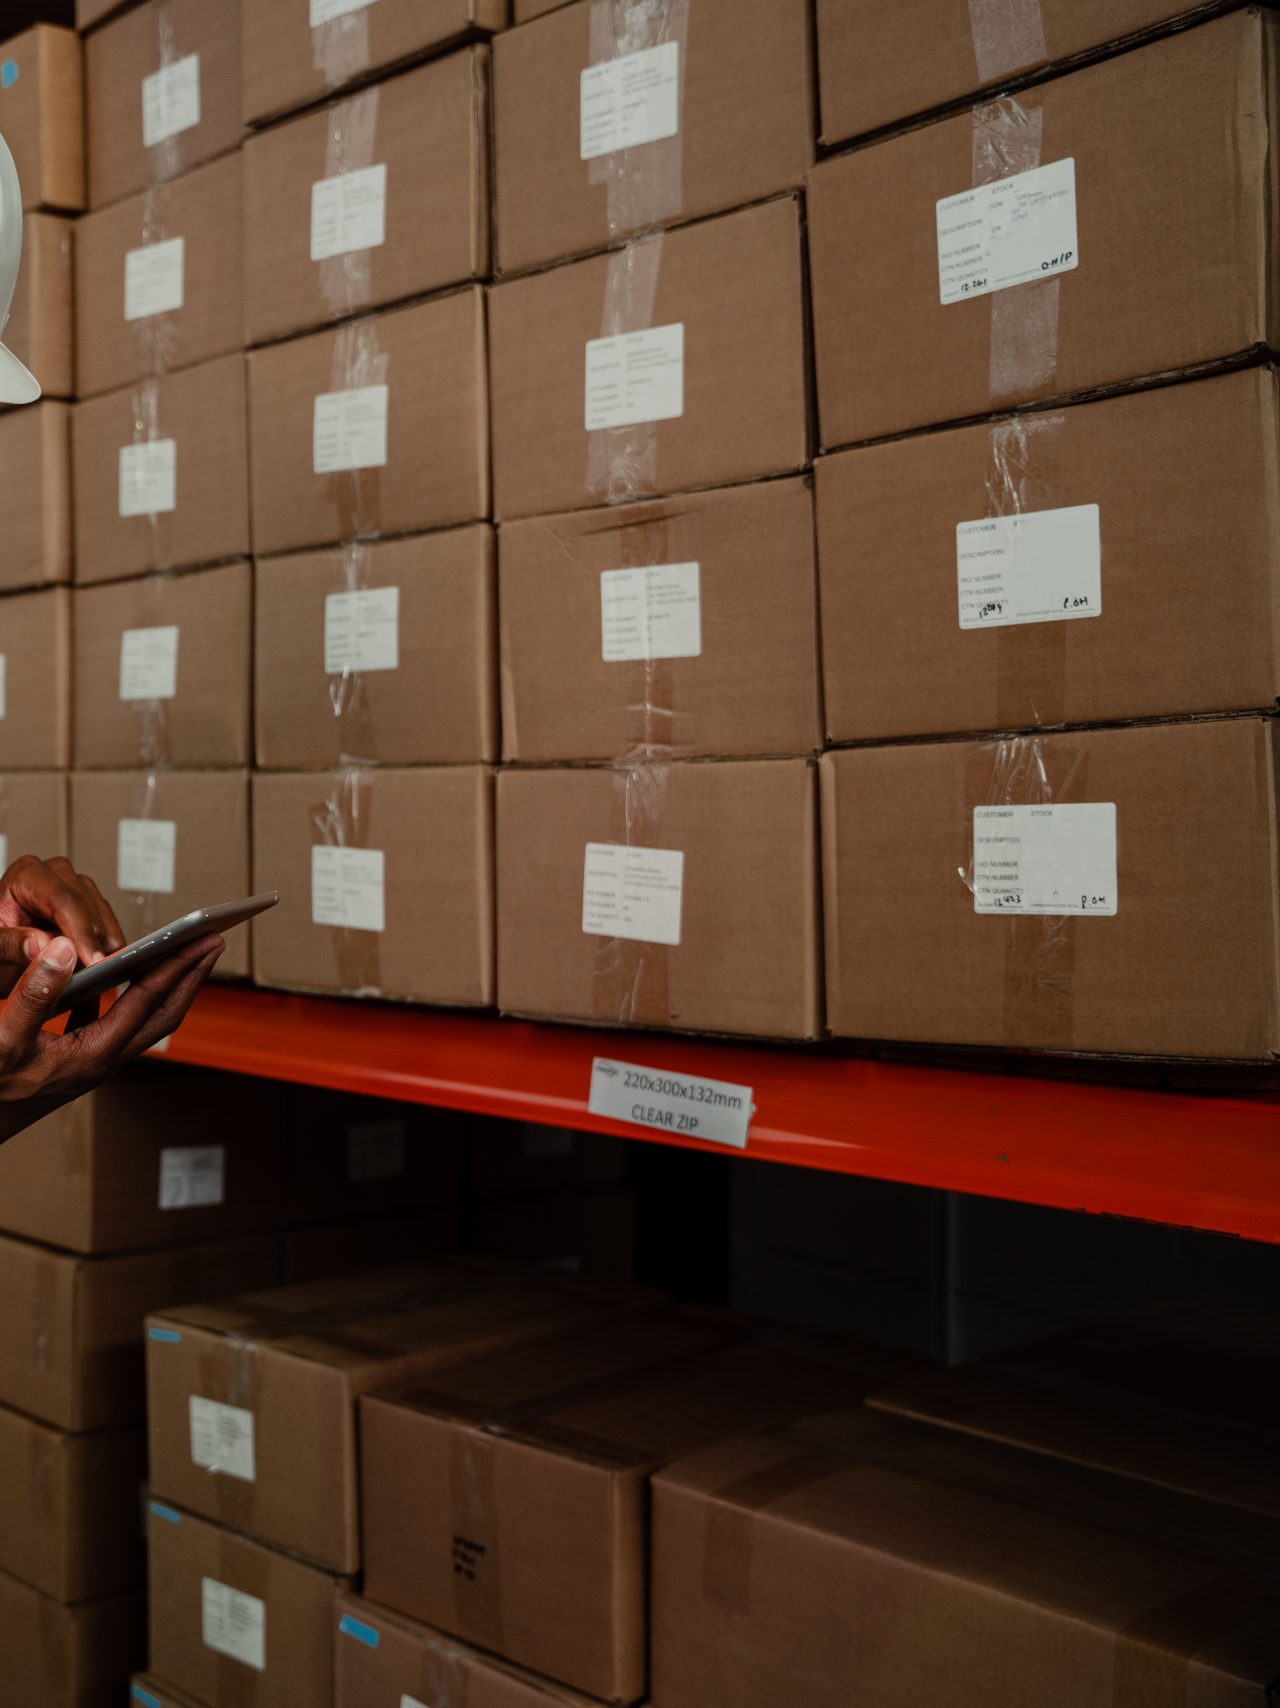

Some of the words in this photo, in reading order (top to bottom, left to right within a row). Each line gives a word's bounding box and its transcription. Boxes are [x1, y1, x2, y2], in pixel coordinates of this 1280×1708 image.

[939, 195, 975, 212] CUSTOMER
[939, 218, 983, 236] DESCRIPTION
[953, 243, 981, 256] NUMBER
[955, 255, 983, 269] NUMBER
[956, 267, 988, 280] QUANTITY
[958, 524, 996, 535] CUSTOMER
[959, 548, 1004, 560] DESCRIPTION
[973, 573, 1001, 583] NUMBER
[960, 588, 974, 597] CTN
[974, 586, 1003, 596] NUMBER
[961, 602, 974, 610] CTN
[976, 836, 1021, 844] DESCRIPTION
[623, 1070, 742, 1110] 220x300x132mm
[630, 1103, 673, 1127] CLEAR
[676, 1113, 699, 1132] ZIP
